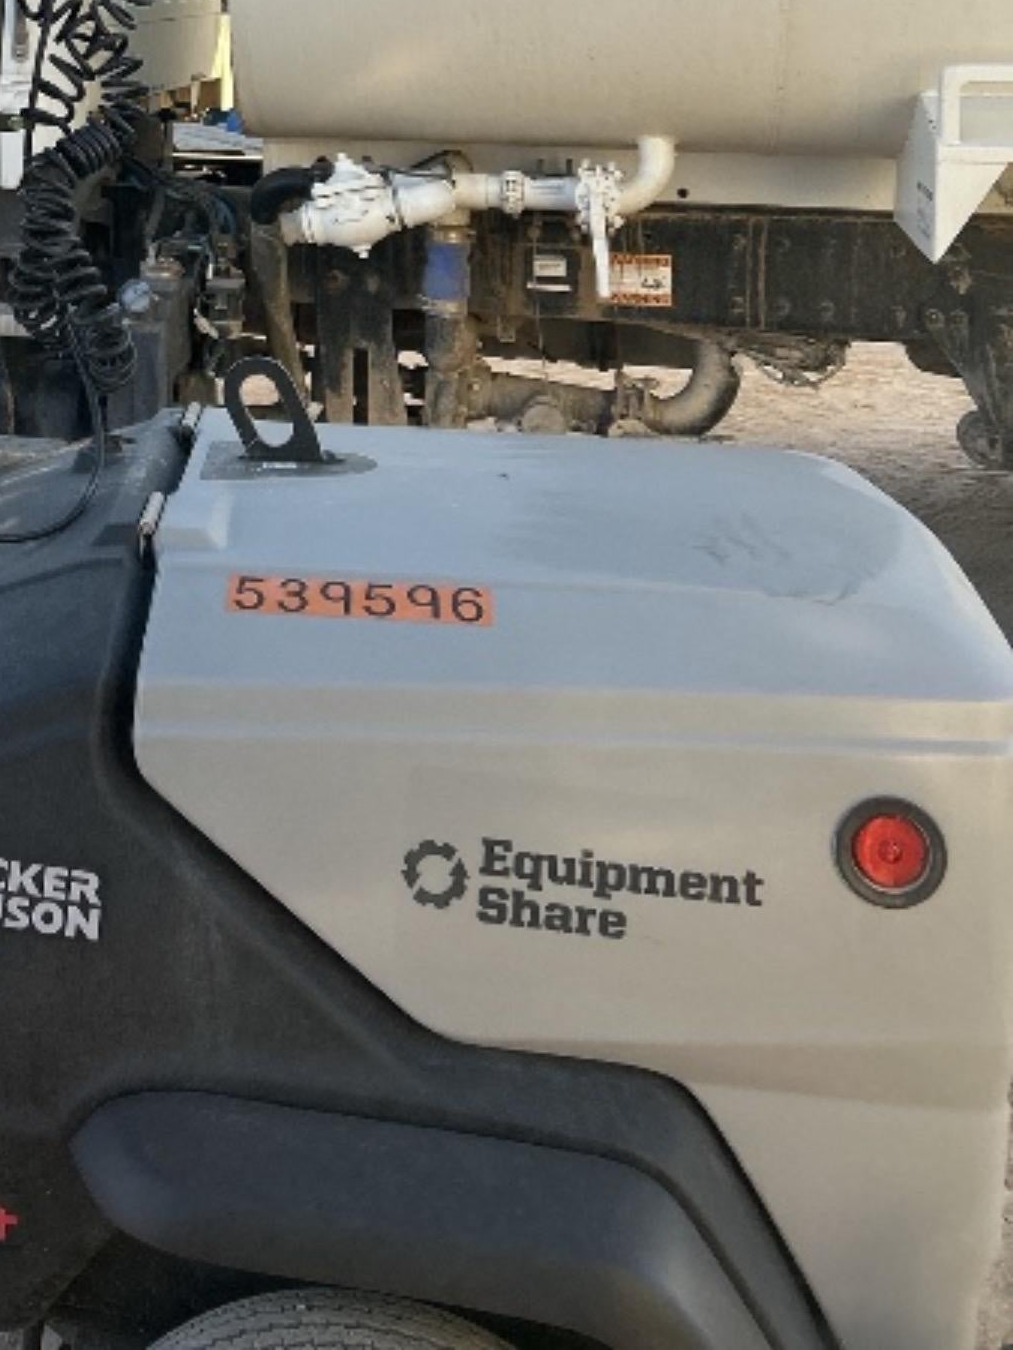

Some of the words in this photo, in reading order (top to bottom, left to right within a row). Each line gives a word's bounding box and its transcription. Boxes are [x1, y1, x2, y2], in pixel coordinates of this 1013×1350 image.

[233, 575, 485, 624] 539596
[478, 836, 764, 907] Equipment
[476, 884, 628, 939] Share
